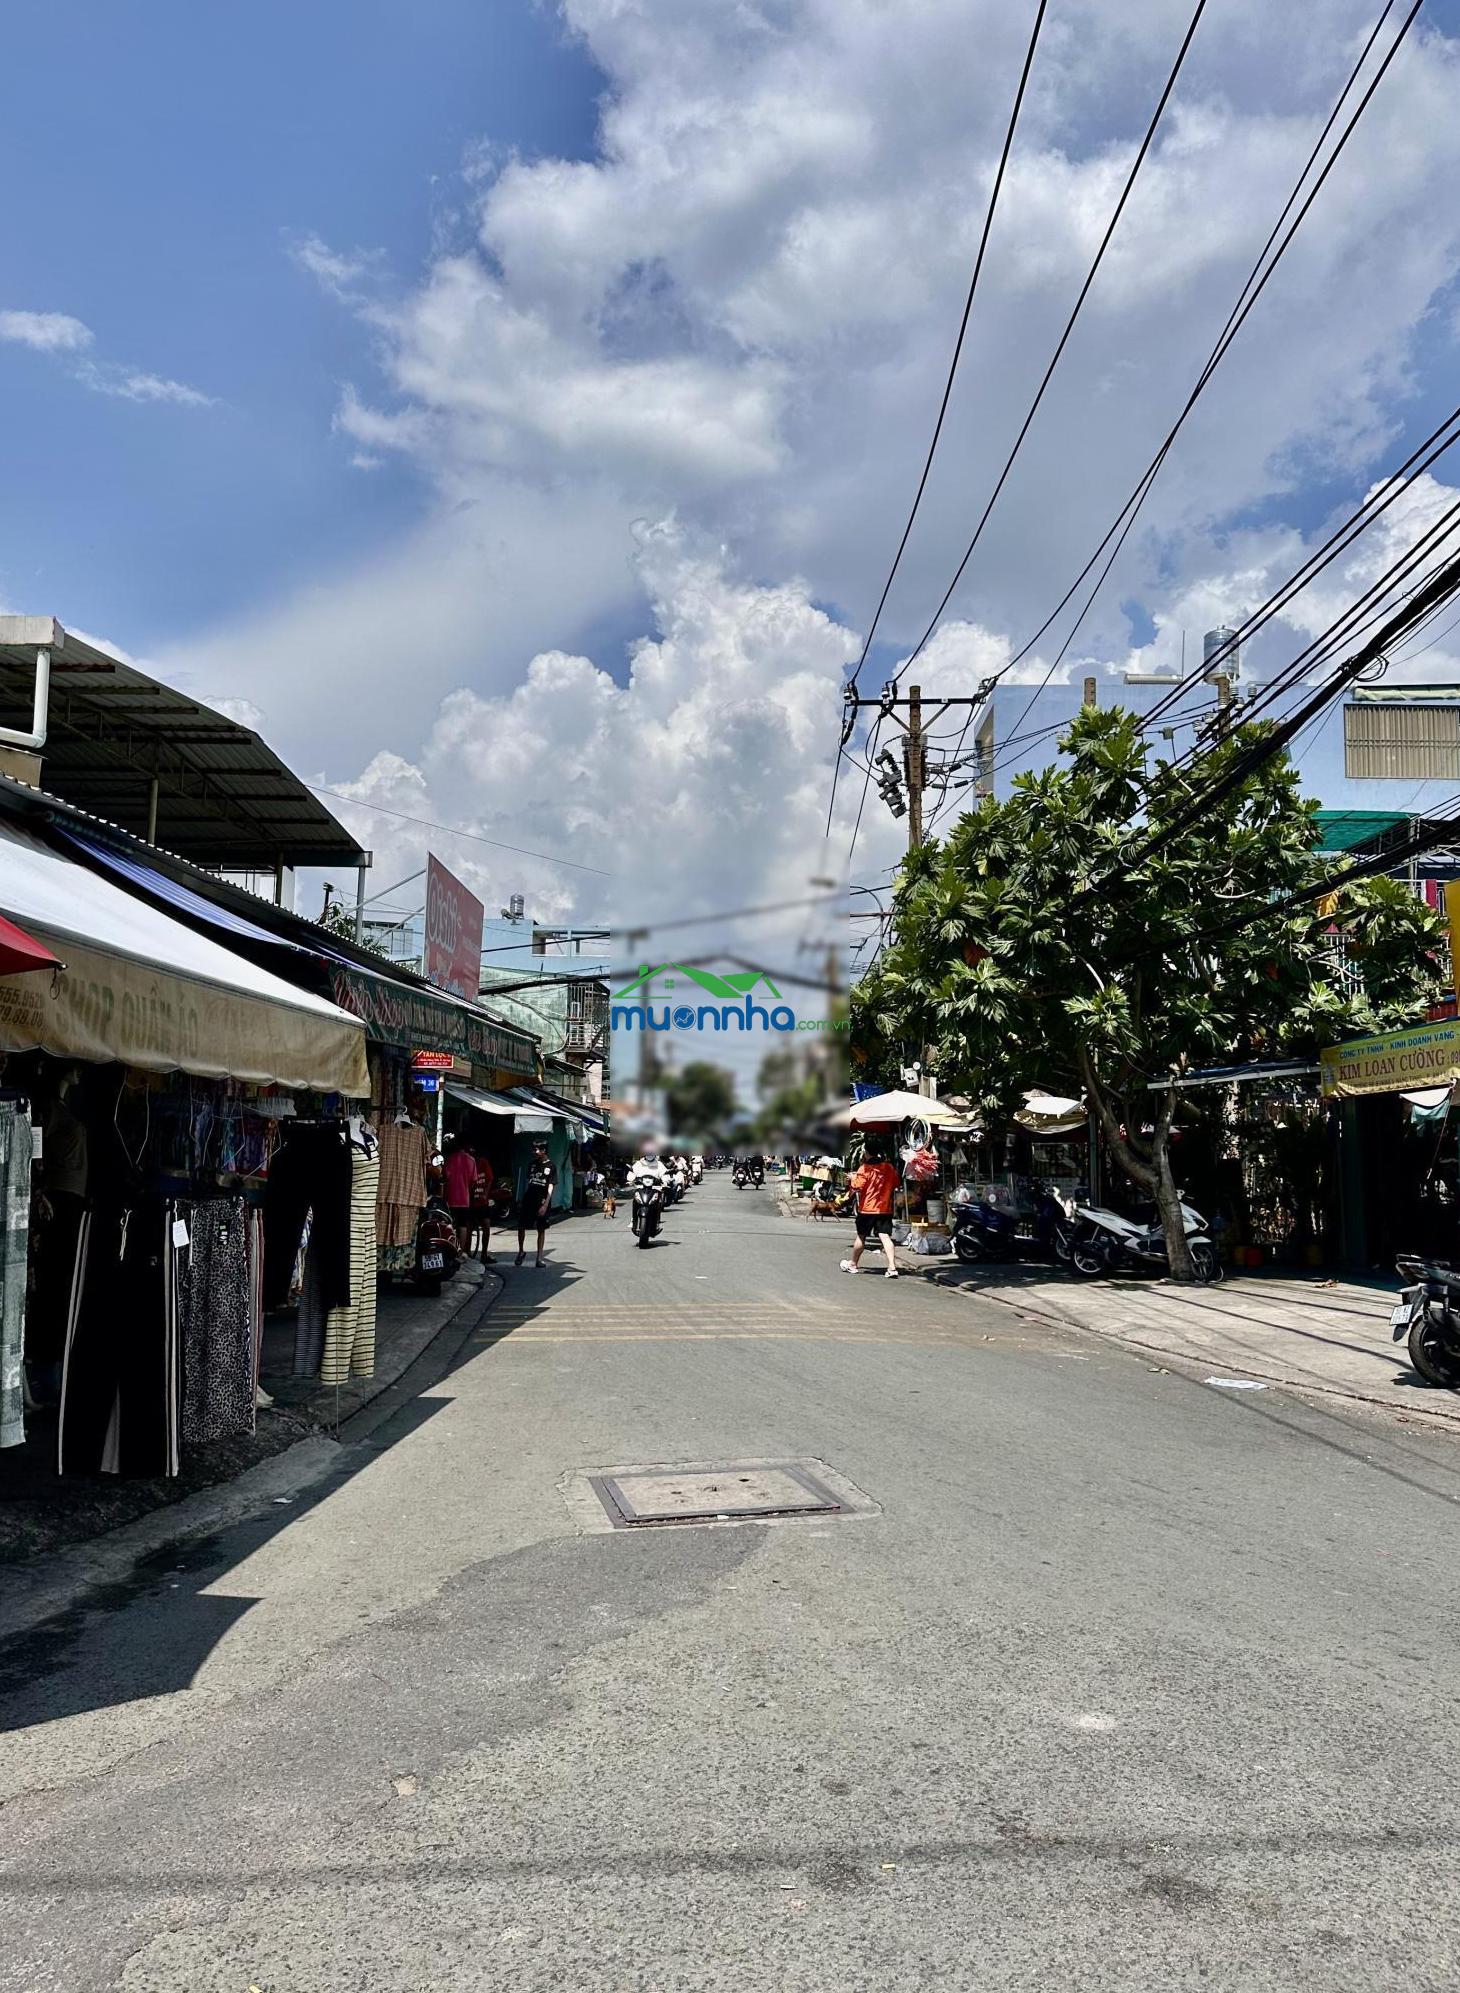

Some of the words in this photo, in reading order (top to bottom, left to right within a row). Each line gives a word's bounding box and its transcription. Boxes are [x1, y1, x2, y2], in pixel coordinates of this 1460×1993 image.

[1407, 1034, 1432, 1047] DOANH
[1339, 1062, 1361, 1081] KIM
[1365, 1056, 1396, 1077] LOAN
[1400, 1046, 1445, 1071] CƯỜNG
